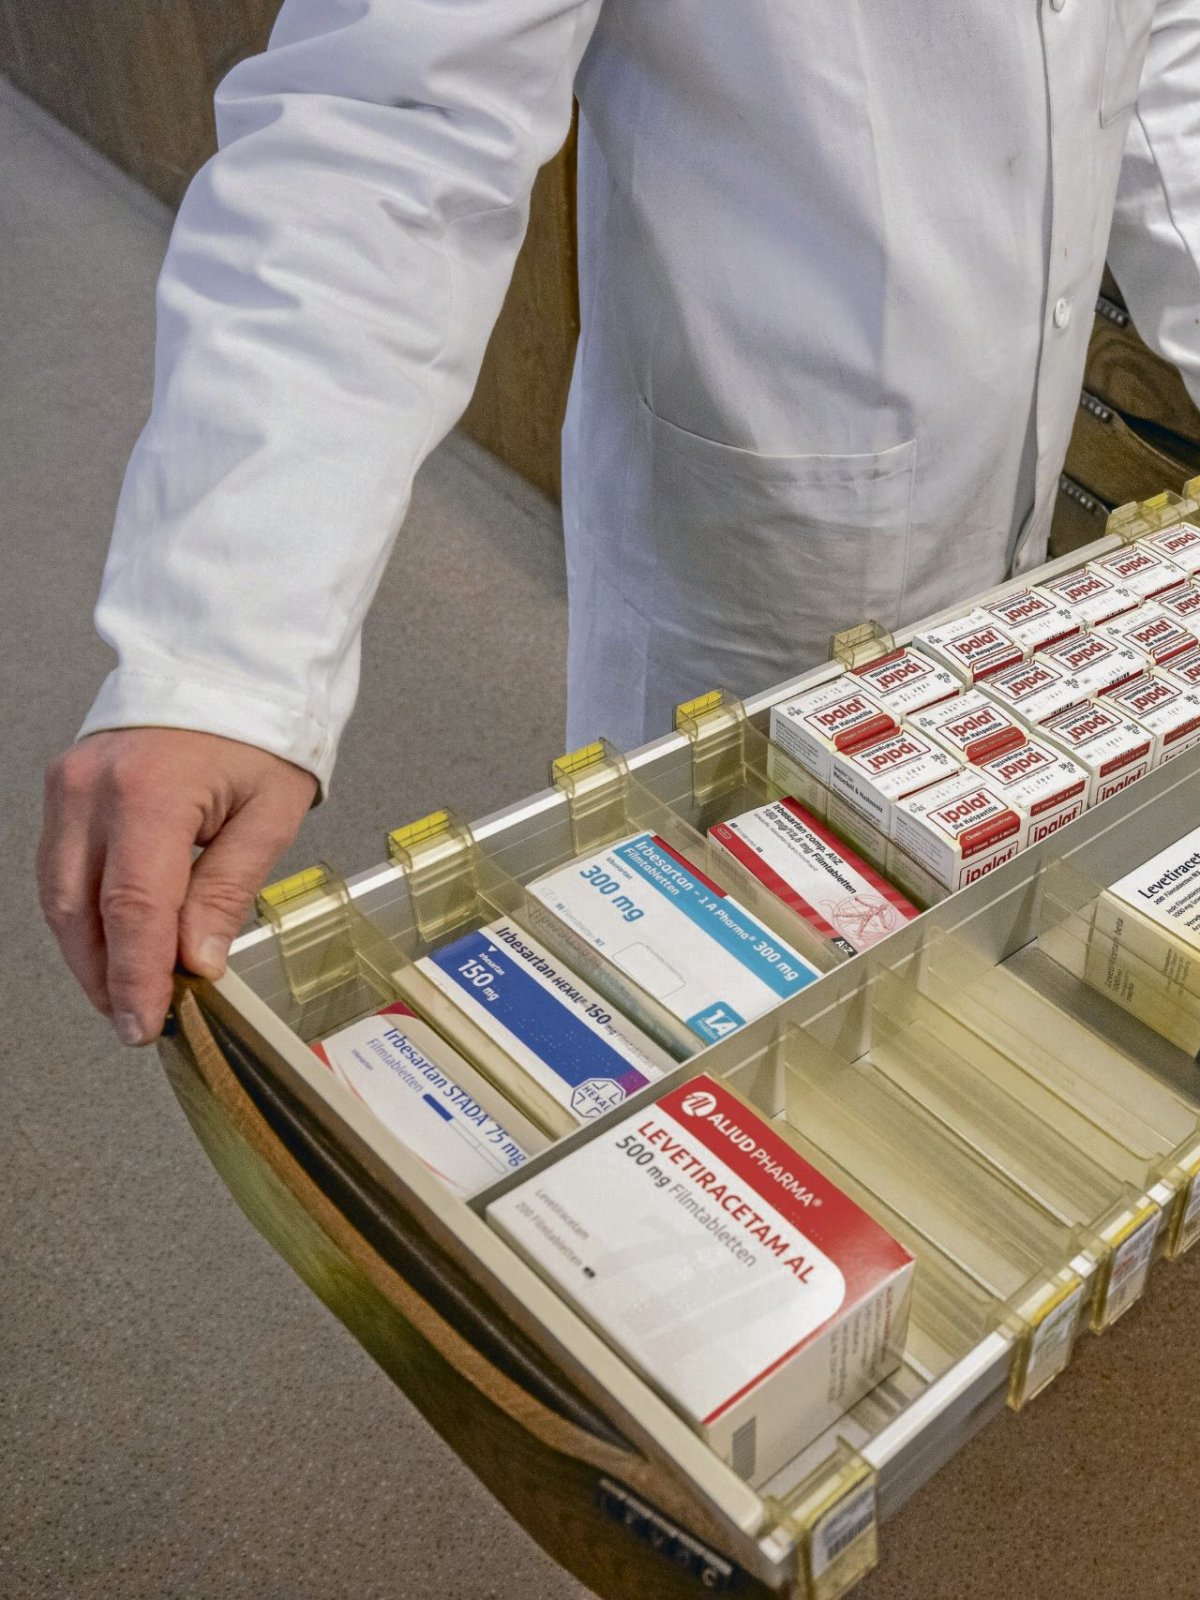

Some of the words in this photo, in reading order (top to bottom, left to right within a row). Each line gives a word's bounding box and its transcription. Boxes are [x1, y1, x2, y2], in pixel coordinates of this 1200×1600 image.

[1065, 580, 1107, 600] ipalat
[1004, 599, 1048, 622] ipalat
[954, 630, 999, 655] ipalat
[1131, 619, 1172, 642] ipalat
[1066, 643, 1110, 670] ipalat
[876, 661, 926, 690] ipalat
[1007, 669, 1054, 696] ipalat
[814, 697, 866, 727] ipalat
[1130, 685, 1175, 711] ipalat
[946, 710, 997, 738] ipalat
[1066, 714, 1114, 741] ipalat
[868, 742, 921, 770] ipalat
[998, 751, 1049, 781] ipalat
[938, 791, 992, 824] ipalat
[772, 804, 806, 835] Irbesartan
[804, 832, 826, 853] comp.
[623, 847, 680, 896] Filmtabletten
[811, 853, 857, 895] Filmtabletten
[579, 864, 621, 895] 300
[612, 894, 645, 923] mg
[634, 840, 693, 892] Irbesartan
[705, 901, 716, 913] A
[753, 940, 780, 964] 300
[777, 961, 799, 982] mg
[458, 958, 494, 987] 150
[482, 986, 500, 1002] mg
[495, 927, 555, 979] Irbesartan
[583, 1003, 613, 1026] 150
[604, 1023, 617, 1036] mg
[366, 1038, 424, 1093] Filmtabletten
[383, 1028, 448, 1089] Irbesartan
[443, 1085, 488, 1127] STADA
[484, 1123, 509, 1144] 75
[500, 1141, 528, 1168] mg
[581, 1084, 613, 1112] HEXAL
[706, 1112, 757, 1153] ALIUD
[615, 1135, 655, 1167] 500
[646, 1162, 672, 1189] mg
[668, 1184, 758, 1269] Filmtabletten
[637, 1120, 791, 1257] LEVETIRACETAM
[784, 1252, 818, 1285] AL
